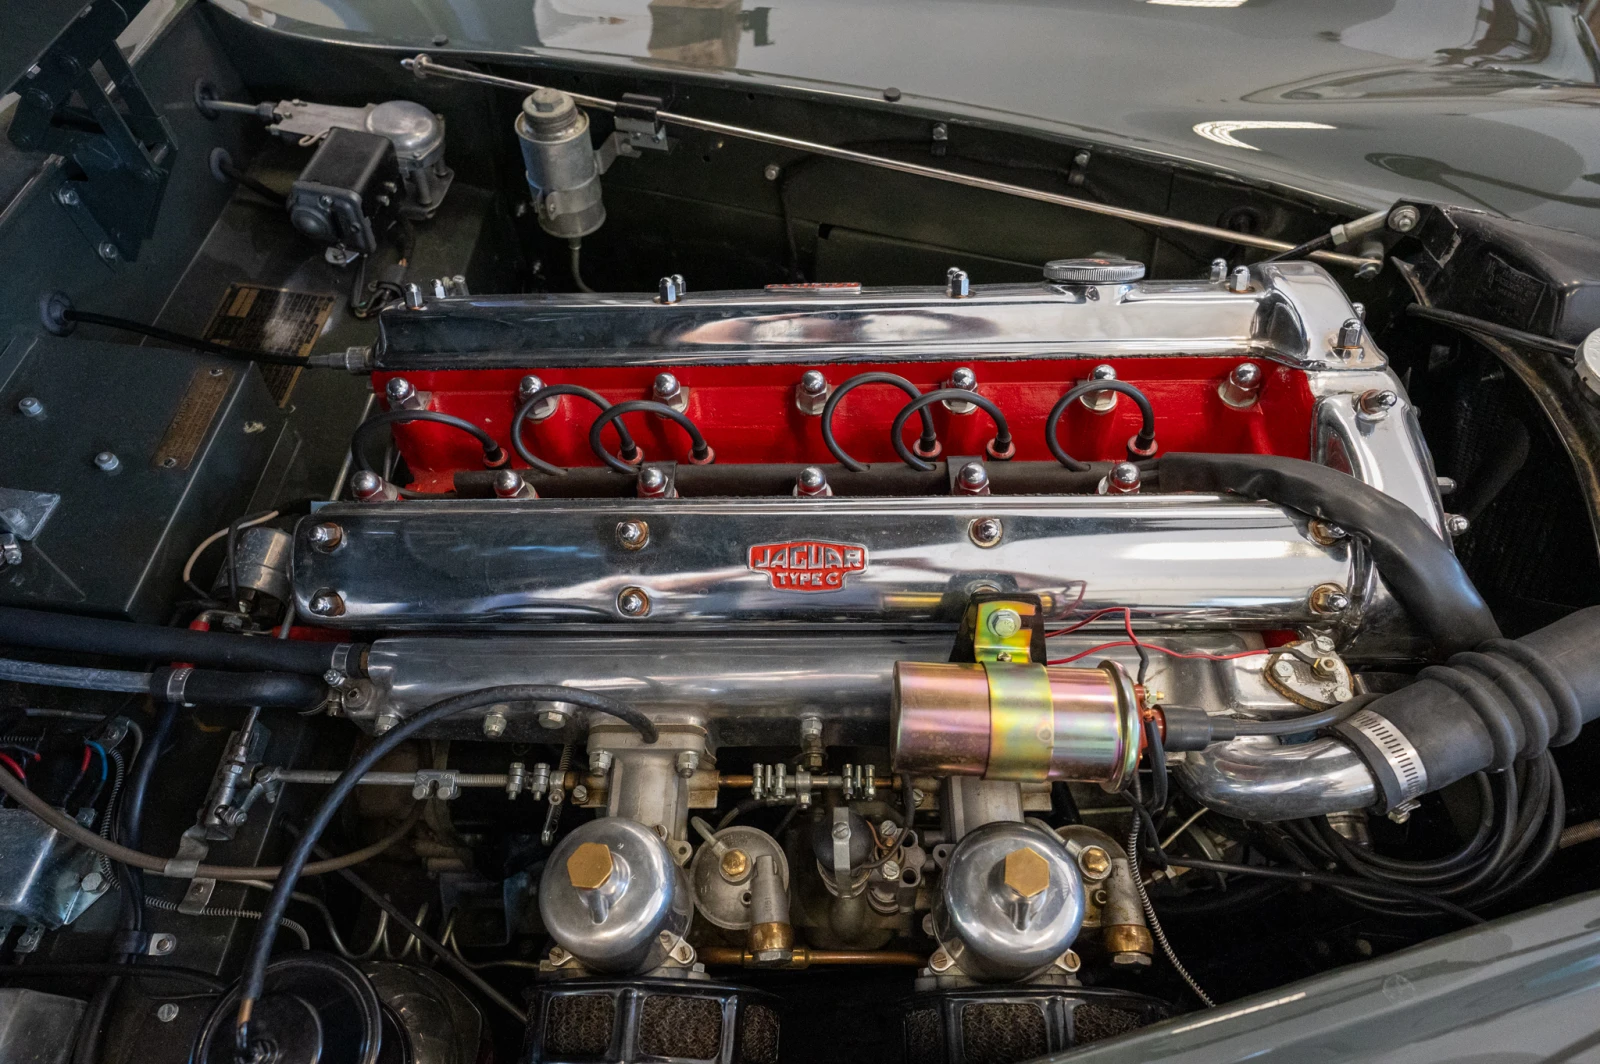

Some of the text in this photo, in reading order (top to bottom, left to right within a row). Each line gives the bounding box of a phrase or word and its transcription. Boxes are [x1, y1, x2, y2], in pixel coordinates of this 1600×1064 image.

[754, 545, 862, 569] JAGUAR
[776, 572, 839, 586] TYPE C
